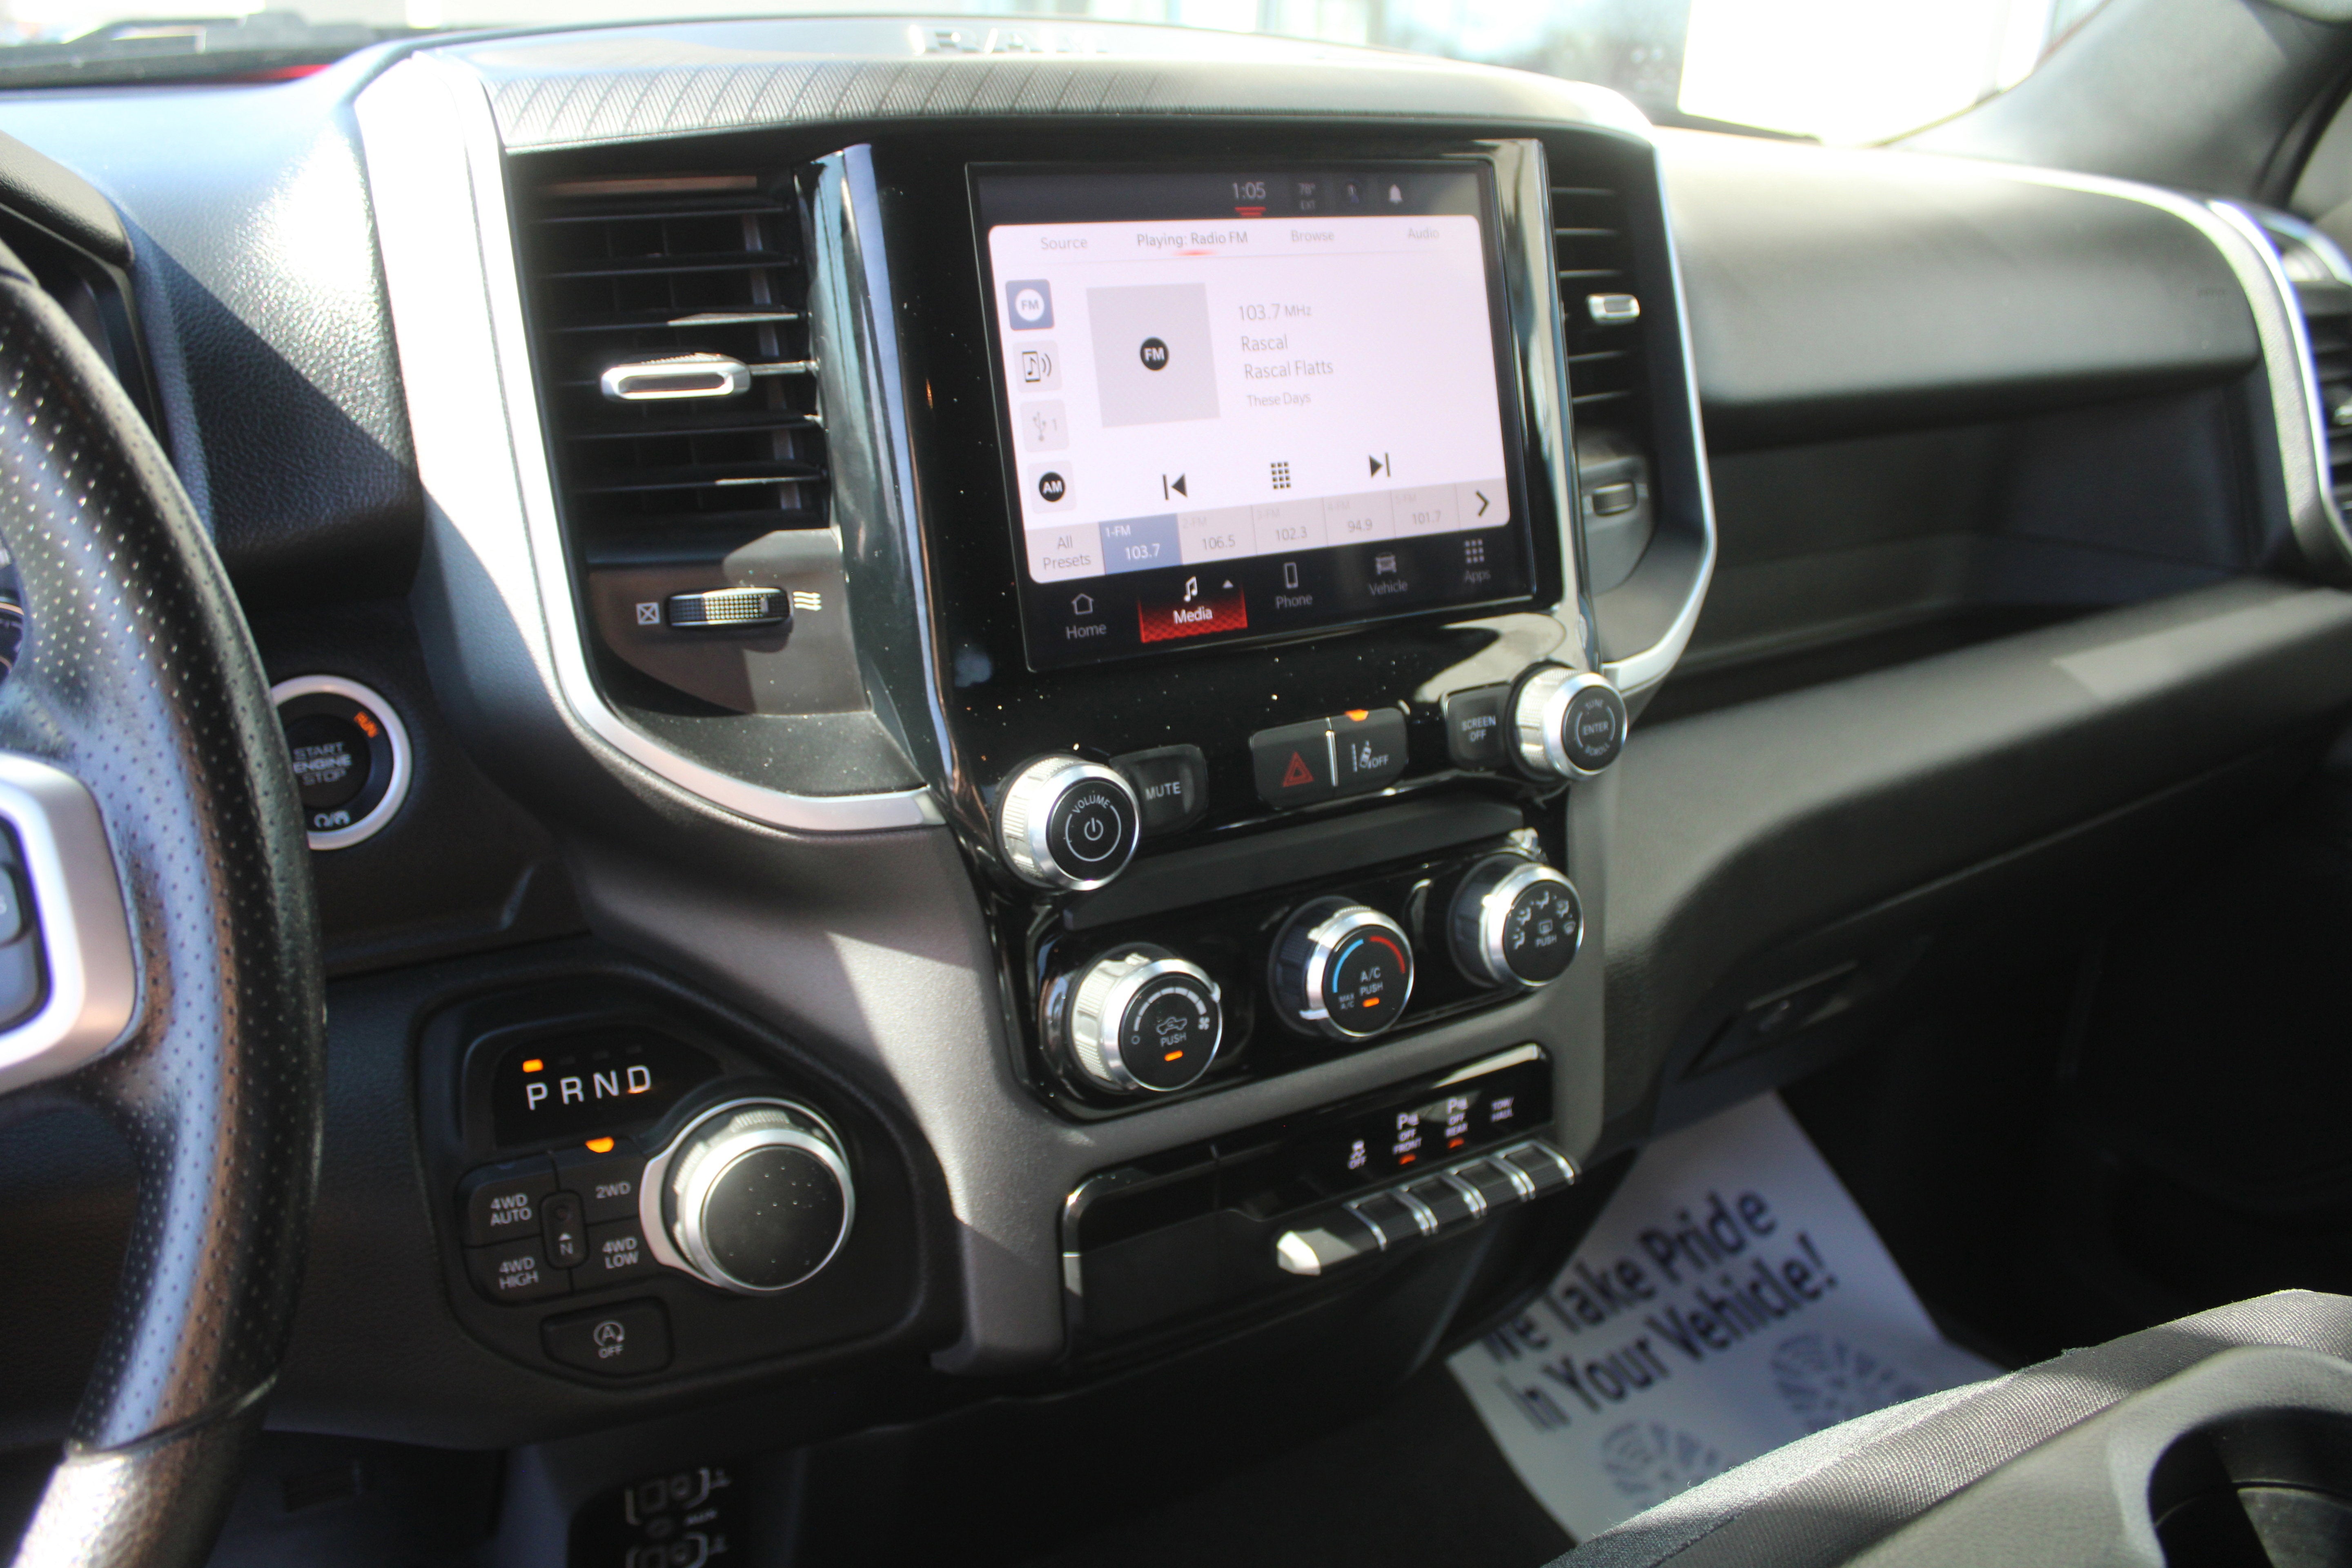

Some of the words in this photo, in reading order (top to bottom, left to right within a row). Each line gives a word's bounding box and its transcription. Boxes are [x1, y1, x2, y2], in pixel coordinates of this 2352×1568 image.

[1232, 181, 1266, 200] 1:05
[1136, 233, 1187, 247] Playing:
[1191, 231, 1226, 245] Radio
[1229, 231, 1248, 243] FM
[1291, 229, 1335, 242] Browse
[1408, 227, 1440, 240] Audio
[1040, 236, 1088, 249] Source
[1021, 300, 1039, 310] FM
[1238, 303, 1281, 321] 103.7
[1285, 304, 1312, 317] MHz
[1241, 334, 1288, 352] Rascal
[1145, 347, 1164, 361] FM
[1245, 361, 1292, 380] Rascal
[1295, 360, 1334, 376] Flatts
[1247, 394, 1281, 408] These
[1283, 392, 1311, 406] Days
[1042, 481, 1062, 494] AM
[1412, 510, 1441, 525] 101.7
[1105, 526, 1131, 538] 1-FM
[1276, 526, 1308, 541] 102.3
[1348, 519, 1373, 533] 94.9
[1058, 535, 1073, 549] All
[1202, 534, 1236, 551] 106.5
[1125, 543, 1160, 560] 103.7
[1043, 553, 1091, 570] Presets
[1465, 570, 1491, 584] Apps
[1369, 579, 1408, 596] Vehicle
[1275, 593, 1313, 609] Phone
[1173, 606, 1213, 624] Media
[1066, 623, 1107, 639] Home
[1585, 699, 1604, 710] TUNE
[1461, 715, 1497, 731] SCREEN
[1582, 721, 1609, 735] ENTER
[1470, 730, 1487, 743] OFF
[294, 742, 343, 760] START
[1584, 742, 1610, 756] SCROLL
[293, 755, 351, 773] ENGINE
[1372, 755, 1389, 769] OFF
[303, 768, 346, 786] STOP
[1145, 781, 1182, 801] MUTE
[1072, 794, 1111, 814] VOLUME
[1535, 935, 1557, 948] PUSH
[1360, 966, 1381, 982] A/C
[1359, 981, 1383, 996] PUSH
[1160, 1032, 1187, 1047] PUSH
[526, 1082, 549, 1110] P
[560, 1077, 584, 1105] R
[593, 1071, 619, 1099] N
[627, 1065, 653, 1094] D
[1449, 1113, 1465, 1125] OFF
[1491, 1109, 1513, 1122] HAUL
[1399, 1128, 1416, 1141] OFF
[1445, 1123, 1468, 1138] REAR
[1393, 1138, 1421, 1154] FRONT
[1349, 1156, 1366, 1169] OFF
[596, 1180, 631, 1199] 2WD
[490, 1193, 528, 1211] 4WD
[490, 1207, 532, 1227] AUTO
[1638, 1187, 1776, 1286] Pride
[559, 1242, 574, 1256] N
[602, 1237, 638, 1255] 4WD
[498, 1256, 536, 1274] 4WD
[605, 1250, 639, 1269] LOW
[498, 1270, 539, 1290] HIGH
[1494, 1373, 1573, 1434] In
[1539, 1335, 1671, 1414] Your
[1644, 1231, 1840, 1363] Vehicle!
[598, 1343, 624, 1358] OFF
